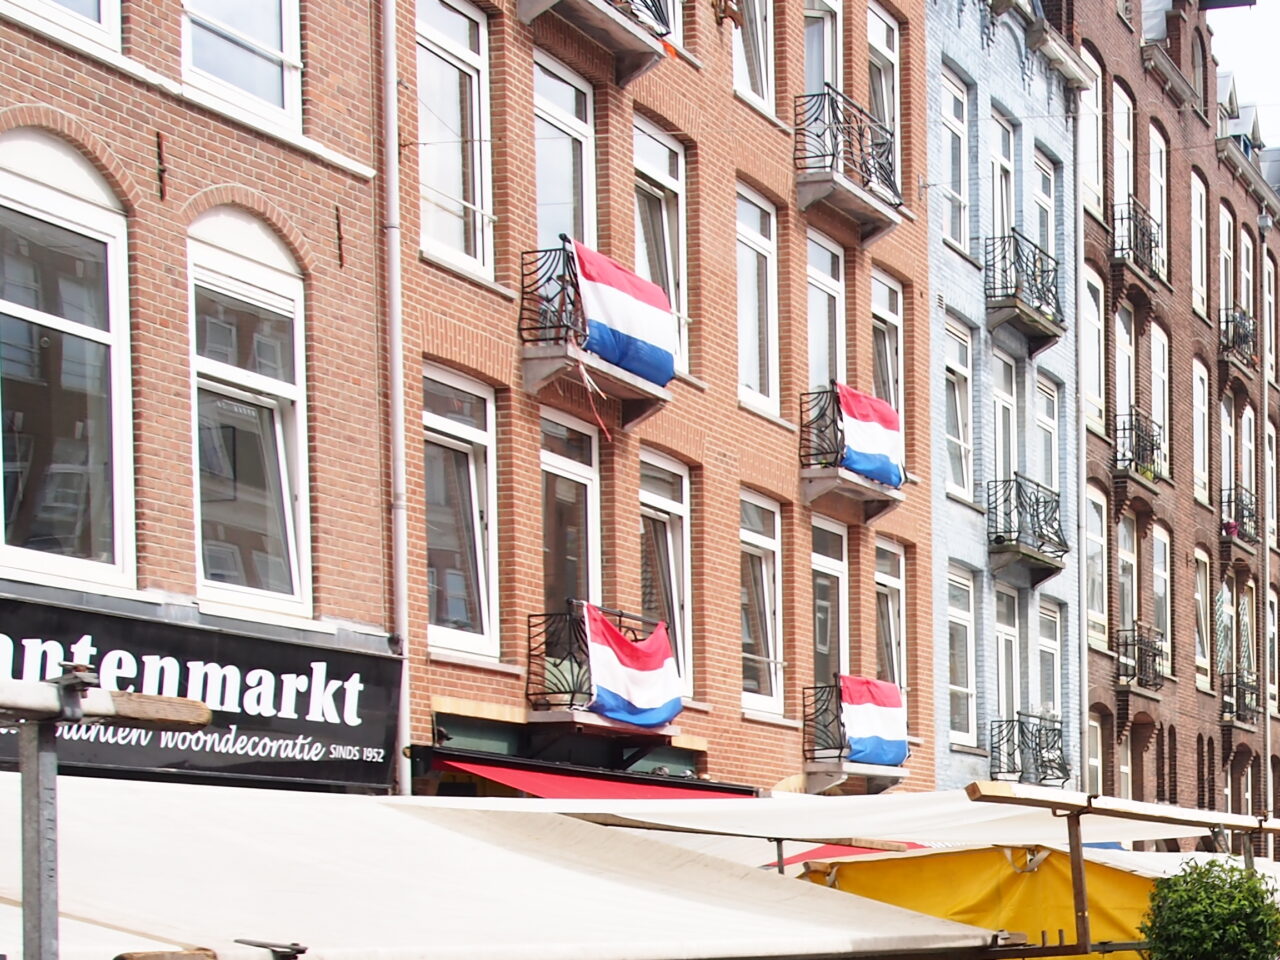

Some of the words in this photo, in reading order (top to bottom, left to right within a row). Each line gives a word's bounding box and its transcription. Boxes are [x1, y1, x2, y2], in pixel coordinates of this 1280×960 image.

[160, 725, 326, 762] woondecoratie
[330, 744, 359, 761] SINDS
[362, 748, 385, 762] 1952
